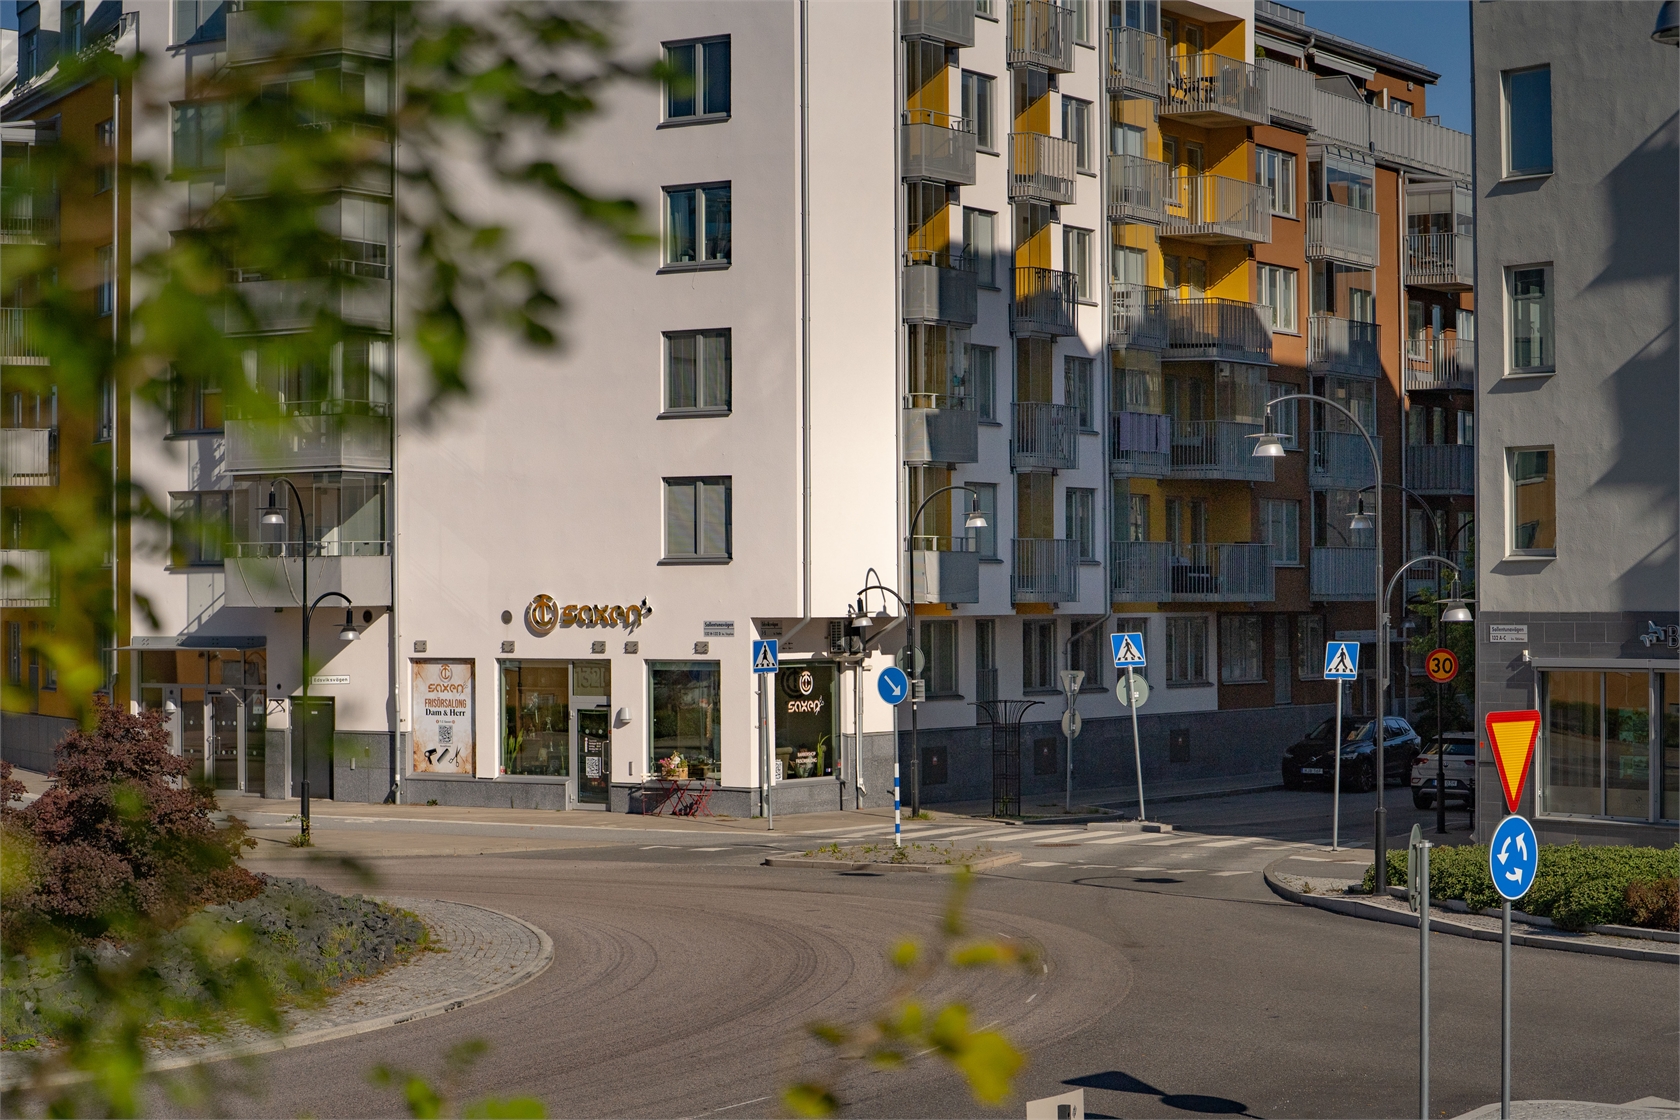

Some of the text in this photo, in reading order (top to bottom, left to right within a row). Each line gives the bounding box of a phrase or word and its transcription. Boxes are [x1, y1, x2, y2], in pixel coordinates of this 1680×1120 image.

[1431, 657, 1453, 674] 30
[424, 697, 467, 708] FRISÖRSALONG
[425, 708, 442, 716] Dam
[449, 708, 466, 717] Herr
